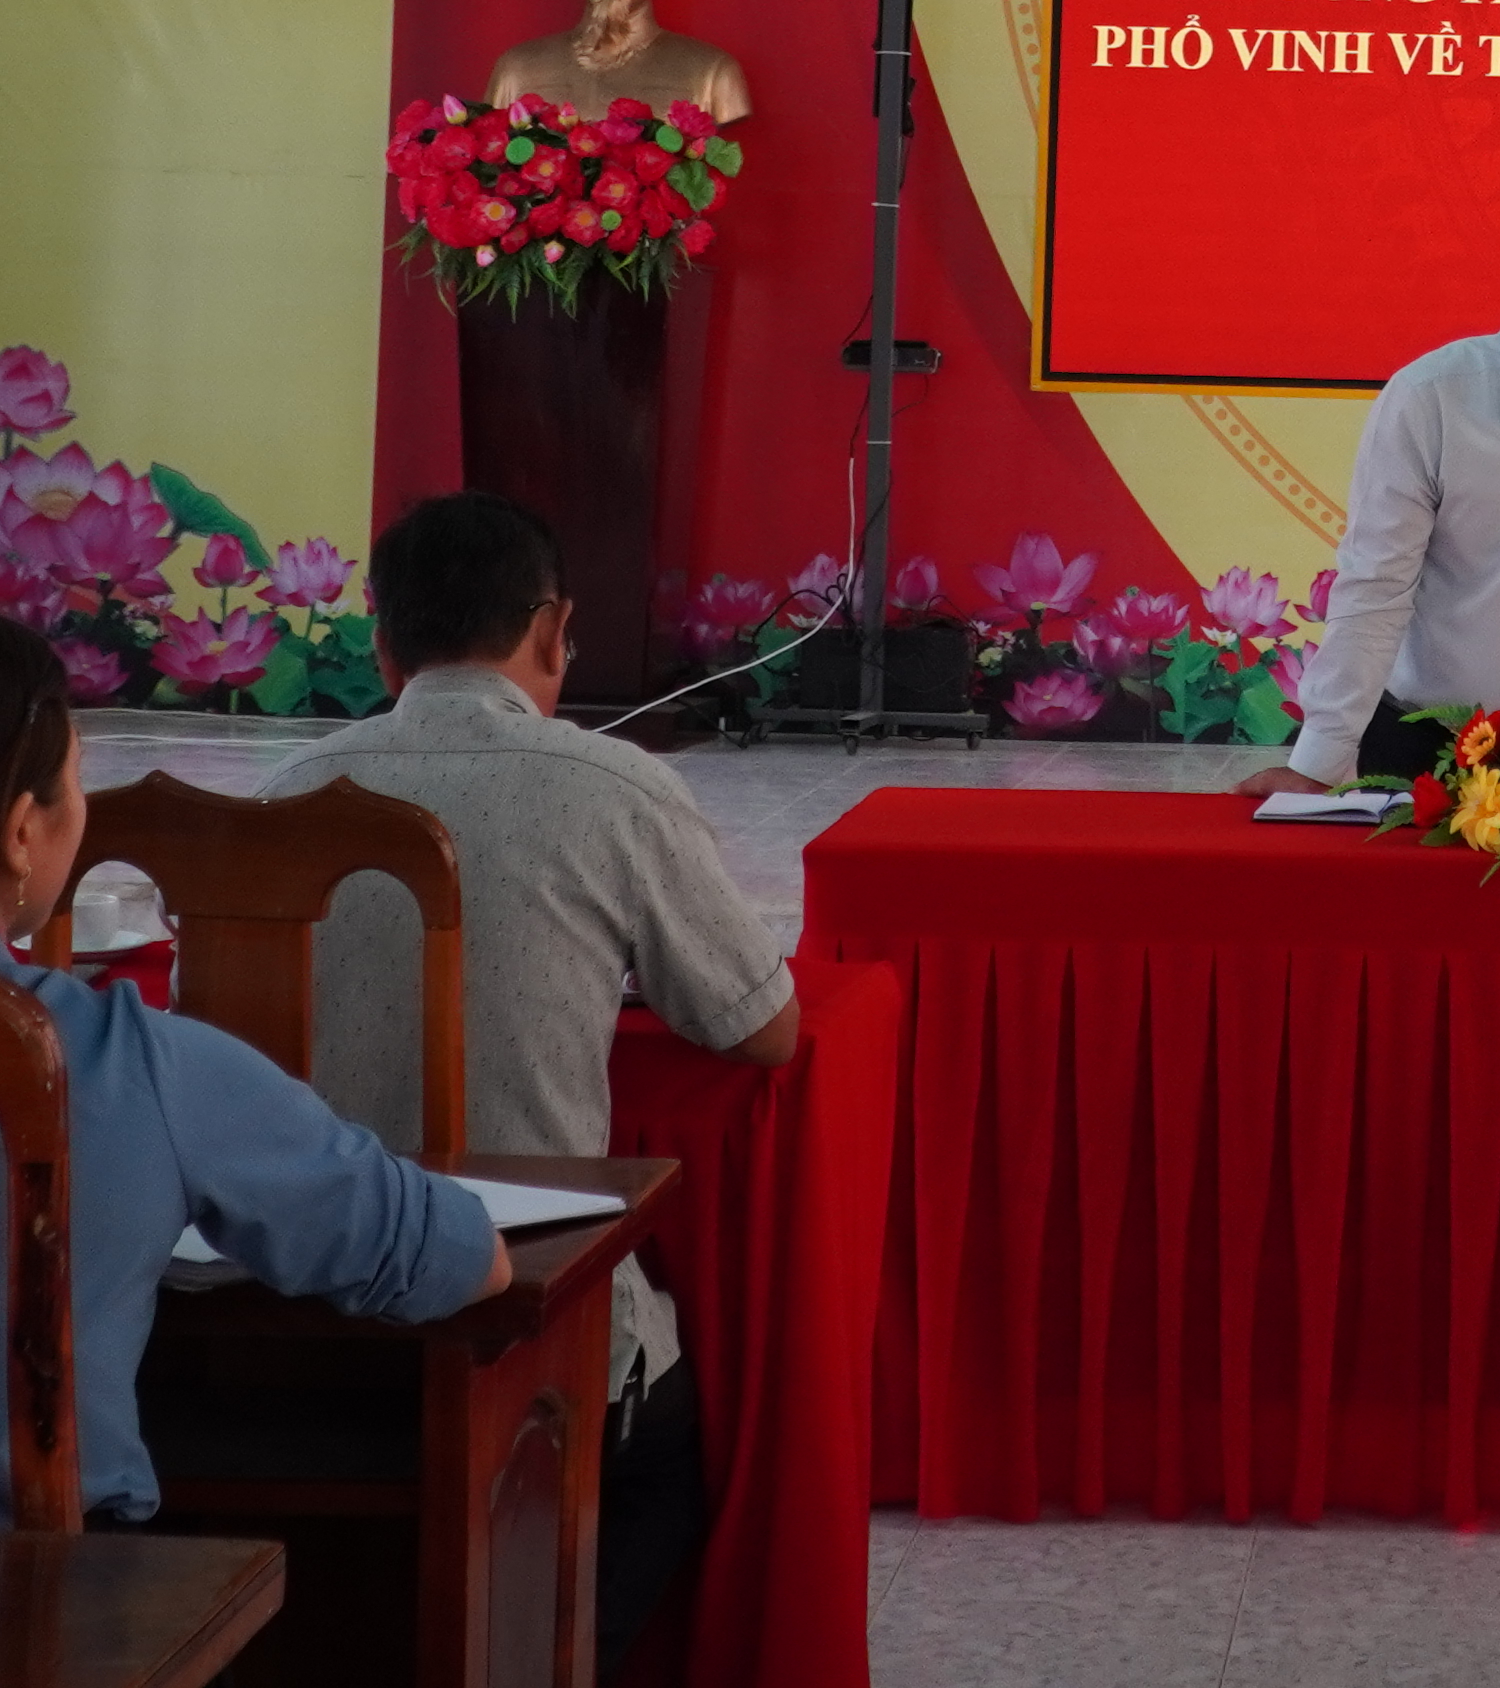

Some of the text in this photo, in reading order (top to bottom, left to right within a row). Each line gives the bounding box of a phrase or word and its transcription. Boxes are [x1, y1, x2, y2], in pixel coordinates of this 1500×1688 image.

[1092, 15, 1213, 69] PHỔ
[1228, 29, 1374, 73] VINH
[1388, 21, 1463, 75] VỀ
